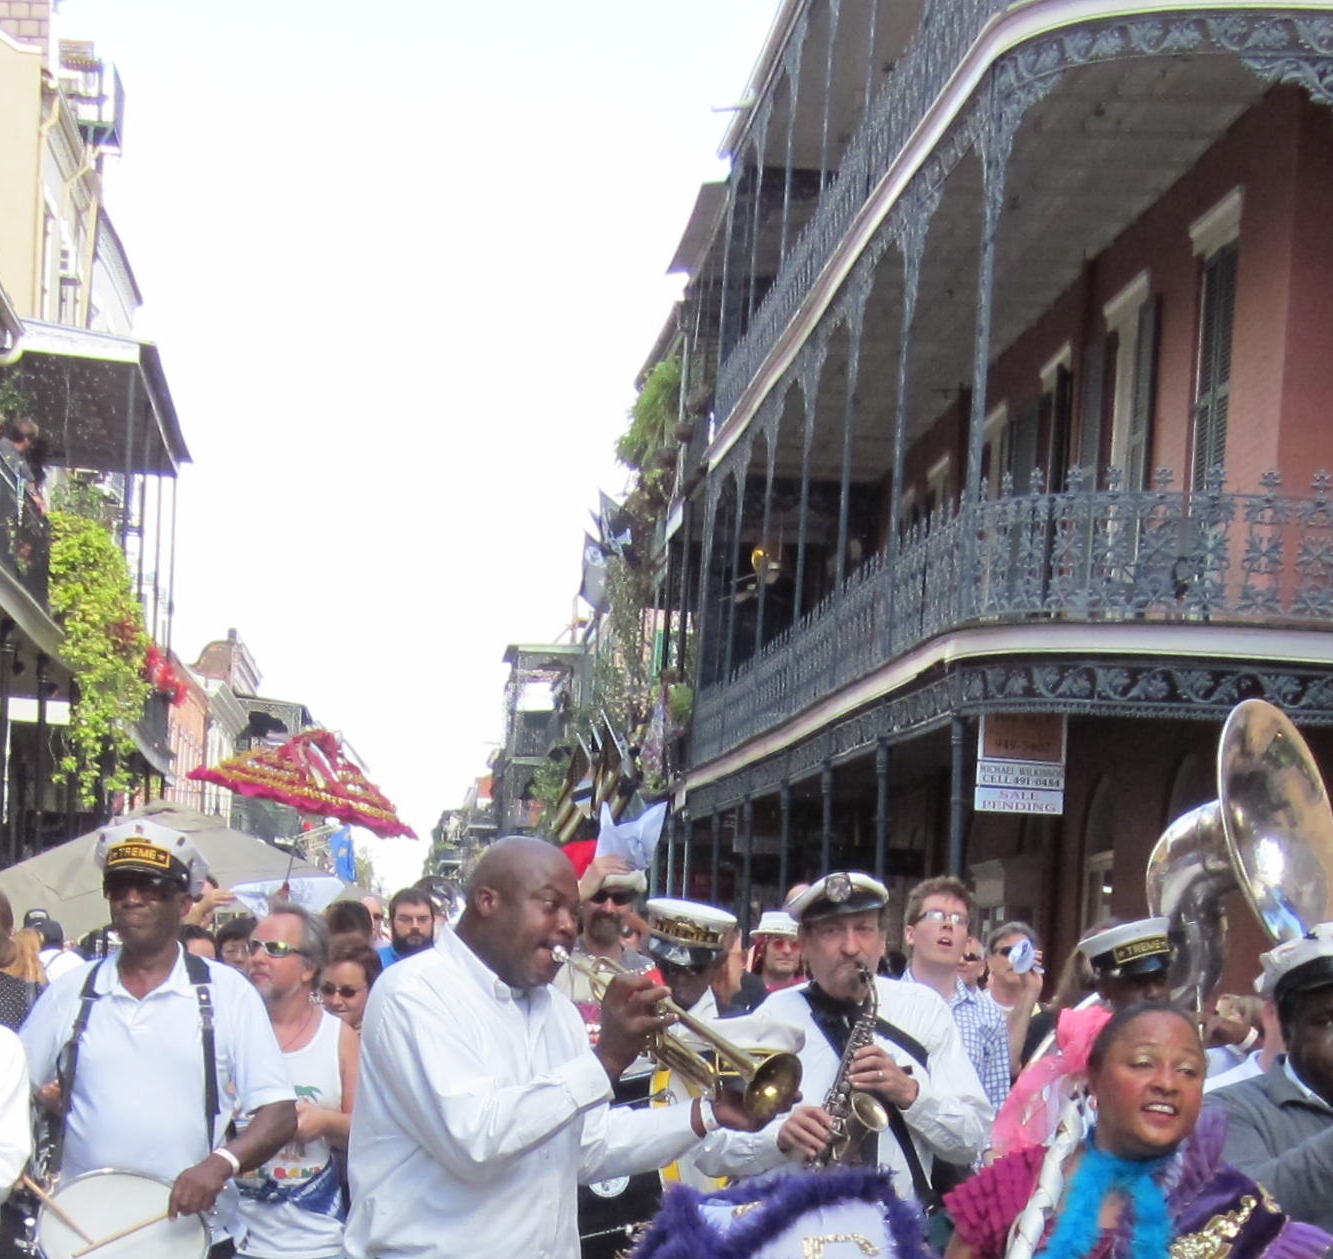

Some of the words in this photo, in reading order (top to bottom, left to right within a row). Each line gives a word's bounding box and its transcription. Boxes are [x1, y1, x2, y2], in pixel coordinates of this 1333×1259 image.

[980, 764, 1014, 775] MICHAEL
[999, 790, 1038, 800] SALE
[982, 801, 1057, 812] PENDING
[117, 846, 157, 860] TREME
